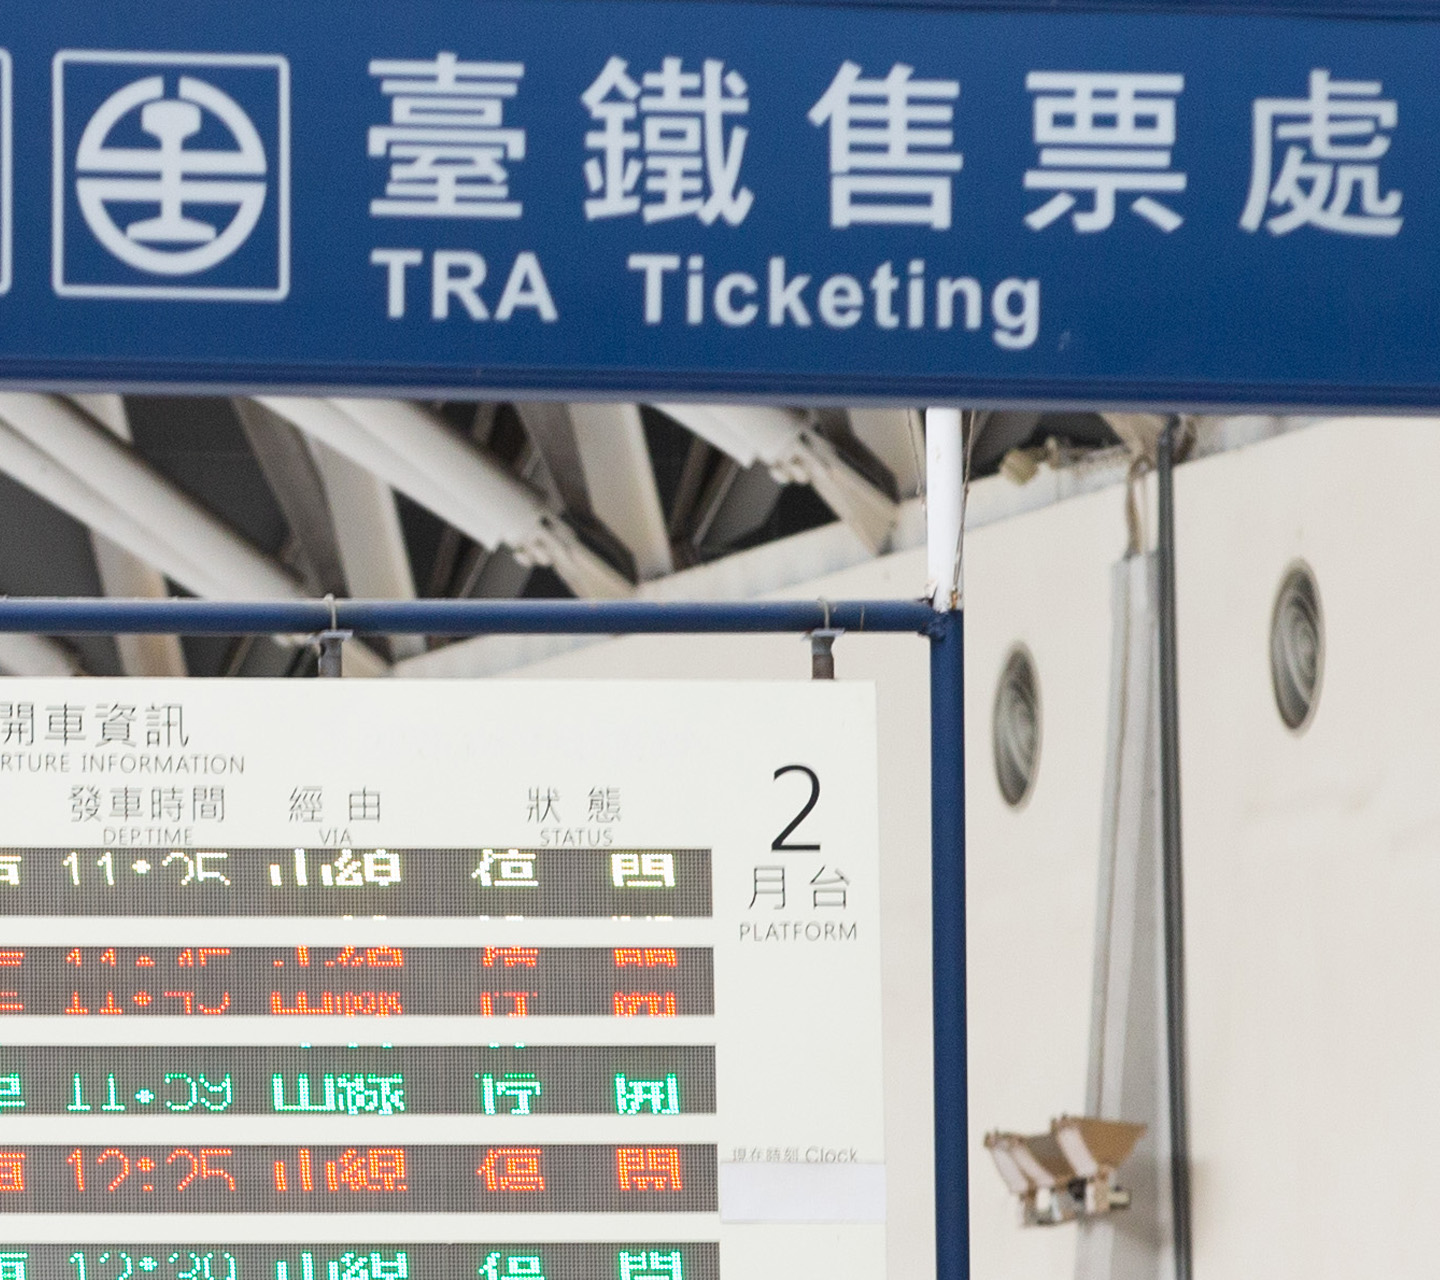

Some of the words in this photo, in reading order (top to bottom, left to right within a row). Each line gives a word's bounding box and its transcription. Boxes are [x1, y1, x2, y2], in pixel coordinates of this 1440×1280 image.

[367, 51, 1403, 237] 臺鐵售票處
[370, 248, 558, 322] TRA
[627, 253, 1040, 350] Ticketing
[82, 754, 245, 774] INFORMATION
[70, 786, 225, 822] 發車時間
[289, 787, 381, 822] 經由
[527, 787, 620, 823] 狀態
[771, 764, 821, 852] 2
[319, 828, 352, 847] VIA
[539, 827, 614, 846] STATUS
[748, 865, 847, 909] 月台
[739, 922, 857, 942] PLATFORM
